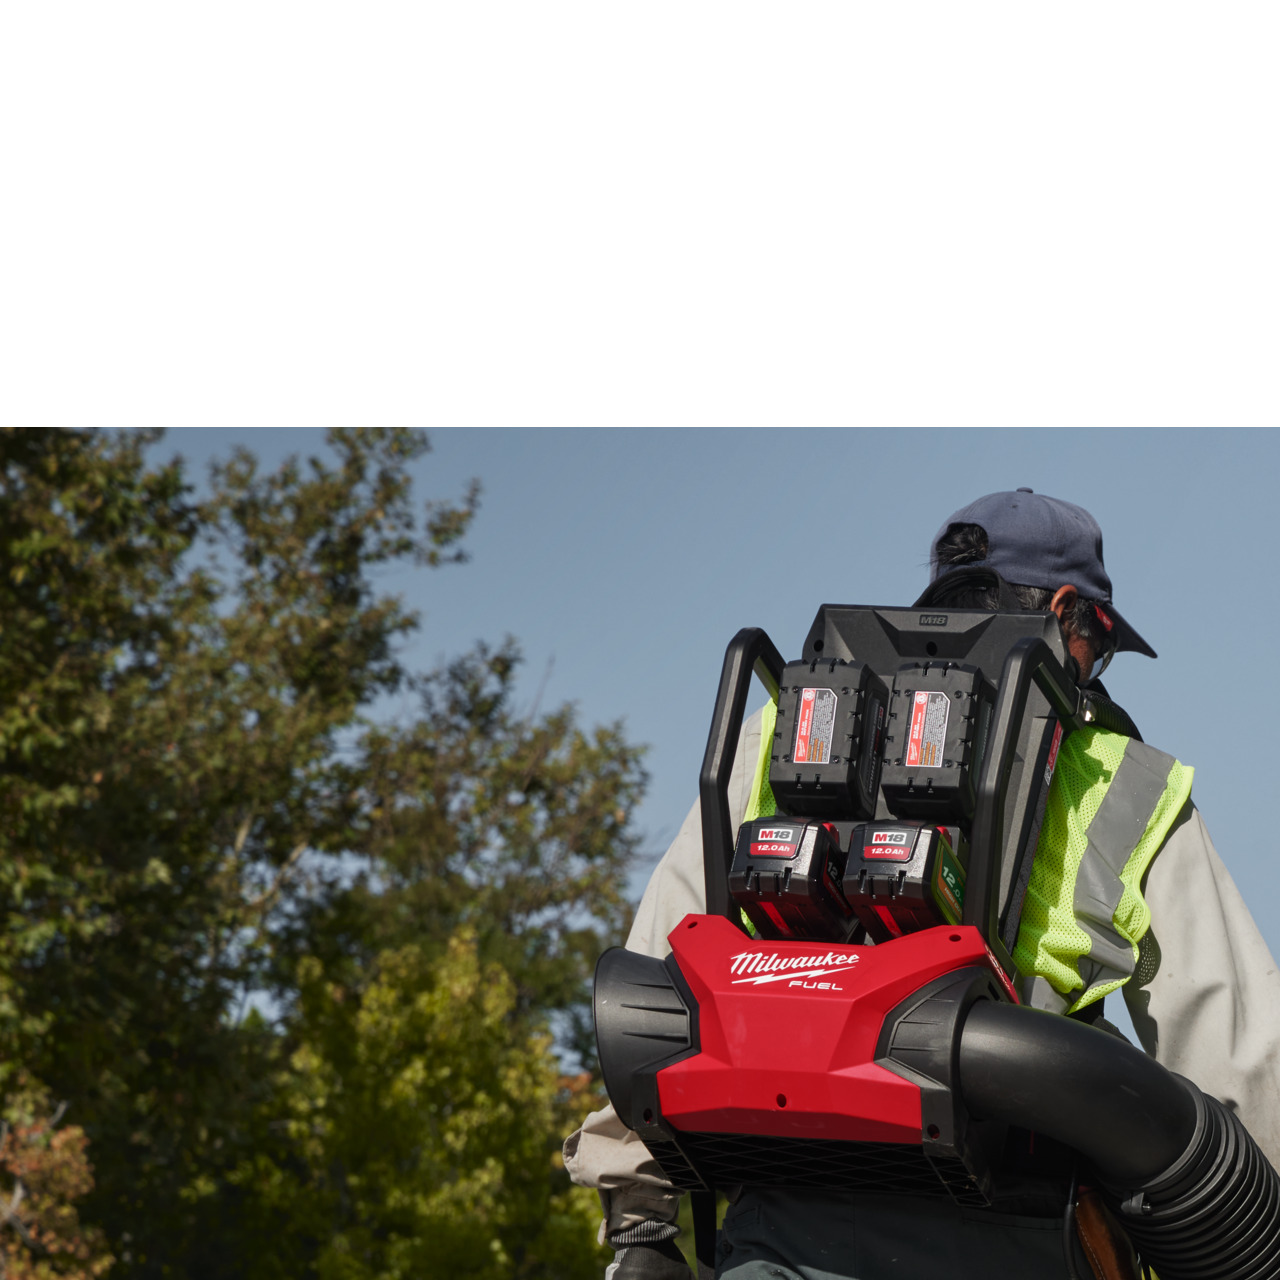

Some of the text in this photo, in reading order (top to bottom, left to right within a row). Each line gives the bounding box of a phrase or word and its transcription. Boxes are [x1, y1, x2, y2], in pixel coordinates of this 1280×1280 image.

[921, 616, 946, 624] M18
[760, 830, 791, 839] M18
[874, 833, 905, 843] M18
[730, 951, 860, 975] Milwaukee
[788, 980, 843, 991] FUEL
